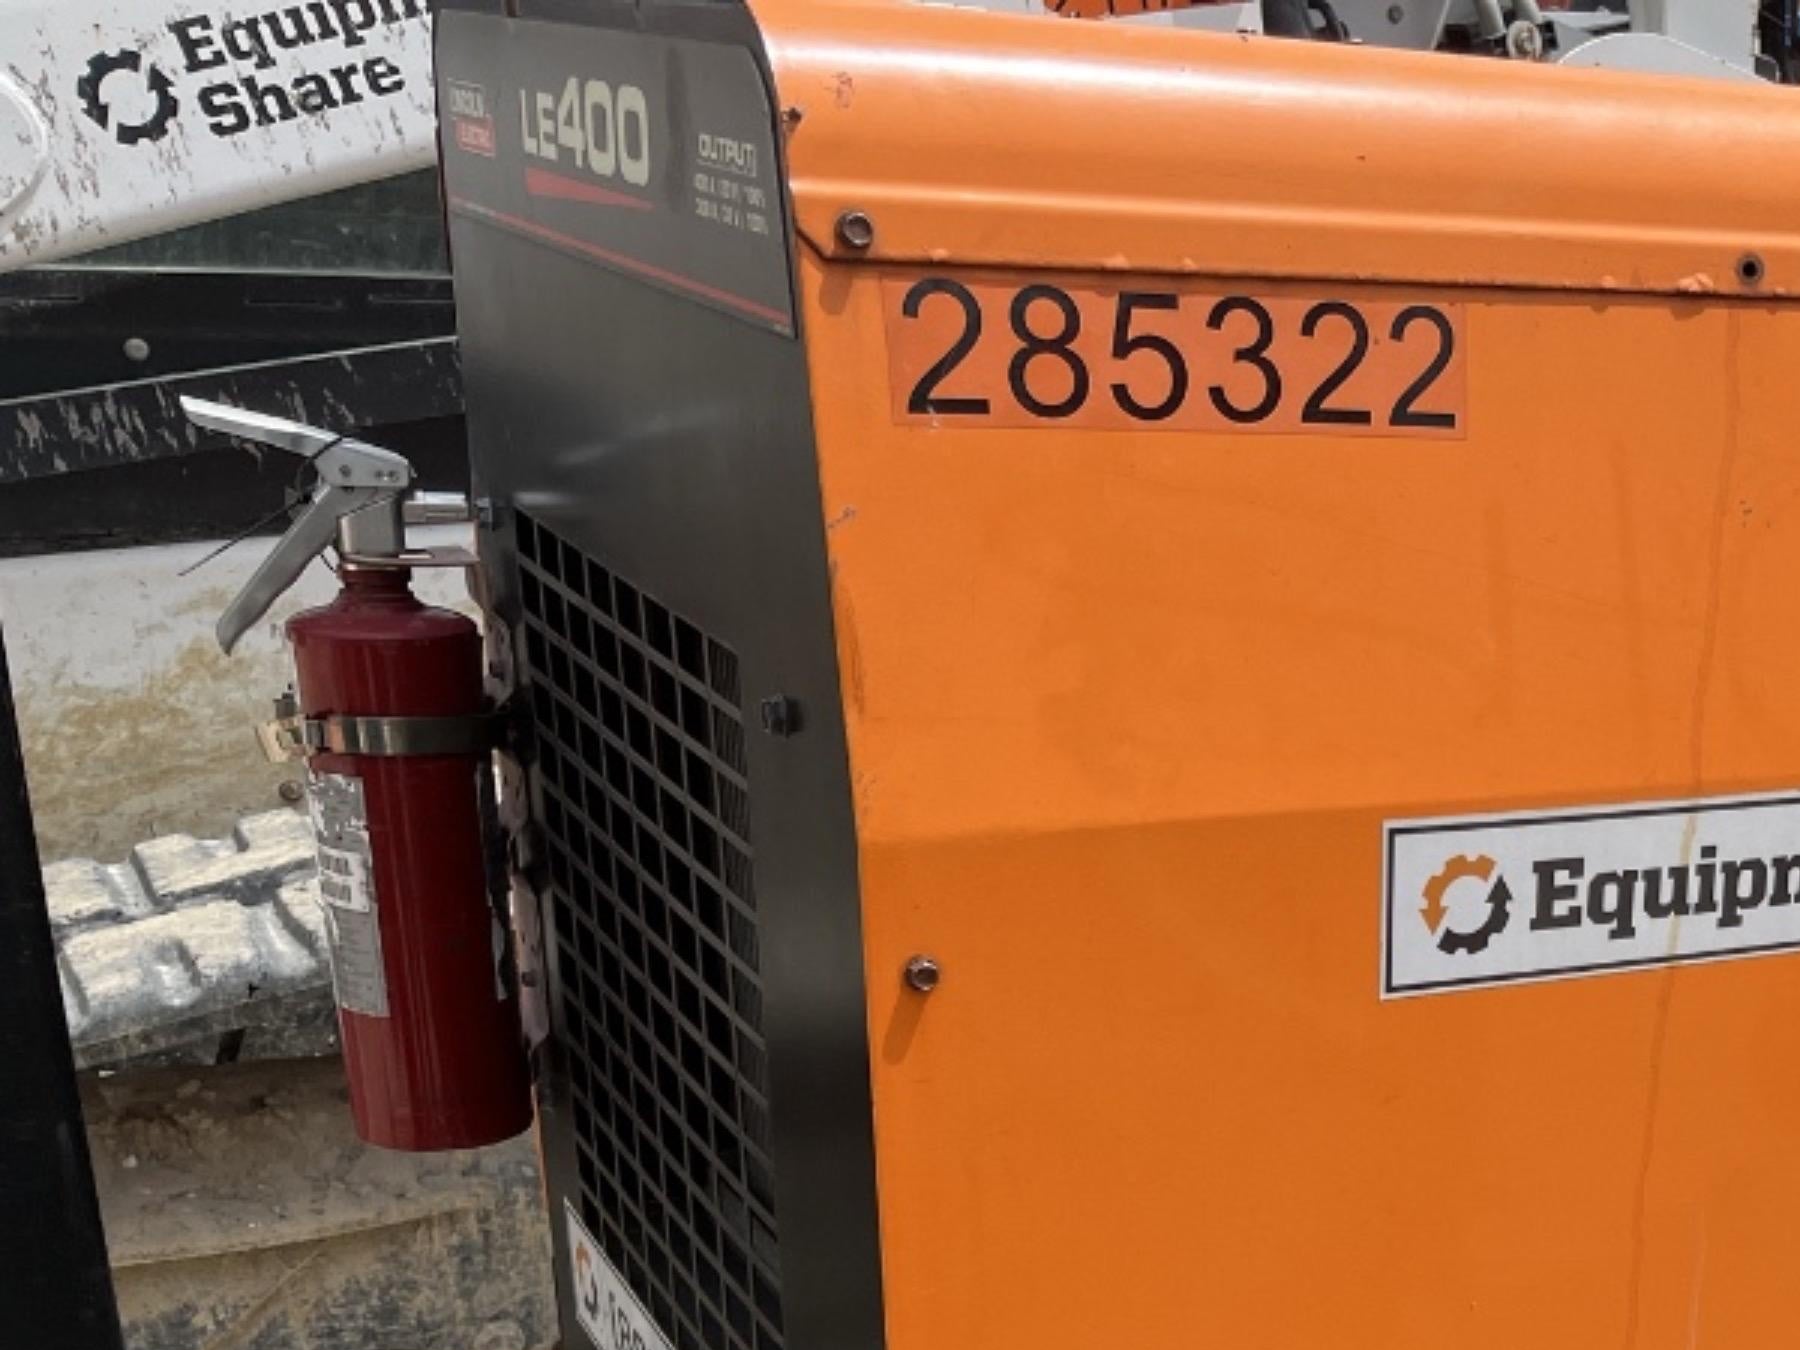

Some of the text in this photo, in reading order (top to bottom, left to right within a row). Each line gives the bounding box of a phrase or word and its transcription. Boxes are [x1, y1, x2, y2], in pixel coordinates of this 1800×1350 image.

[197, 56, 405, 138] Share
[520, 76, 648, 186] LE400
[902, 278, 1456, 428] 285322
